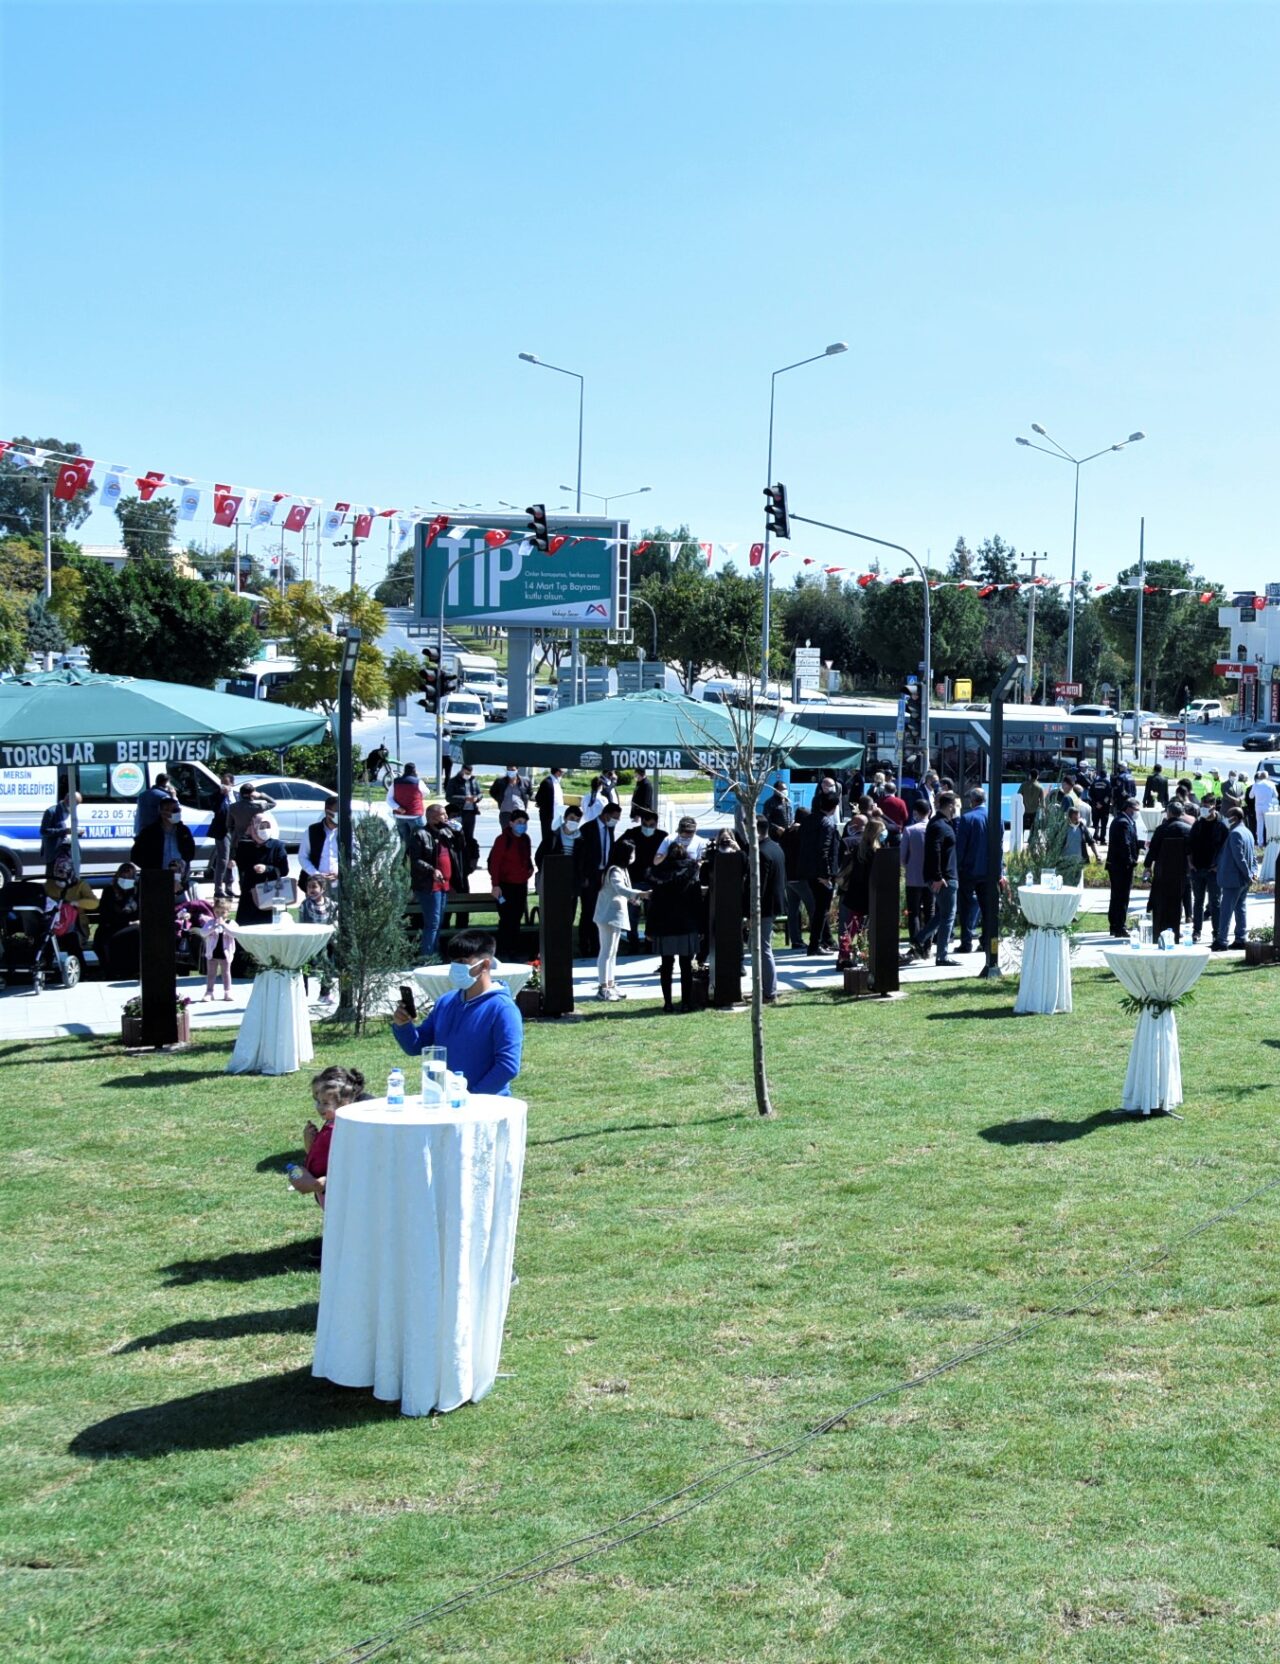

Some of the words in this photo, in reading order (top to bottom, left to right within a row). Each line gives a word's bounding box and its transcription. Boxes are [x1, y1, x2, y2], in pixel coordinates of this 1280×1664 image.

[437, 538, 523, 607] TIP
[524, 581, 534, 590] 14
[536, 581, 554, 590] Mart
[524, 591, 542, 600] kutlu
[1, 742, 96, 767] TOROSLAR
[611, 750, 681, 769] TOROSLAR
[3, 770, 32, 779] MERSİN
[18, 781, 56, 796] BELEDİYESİ
[91, 809, 110, 819] 223
[112, 809, 124, 819] 05
[89, 825, 114, 838] NAKİL
